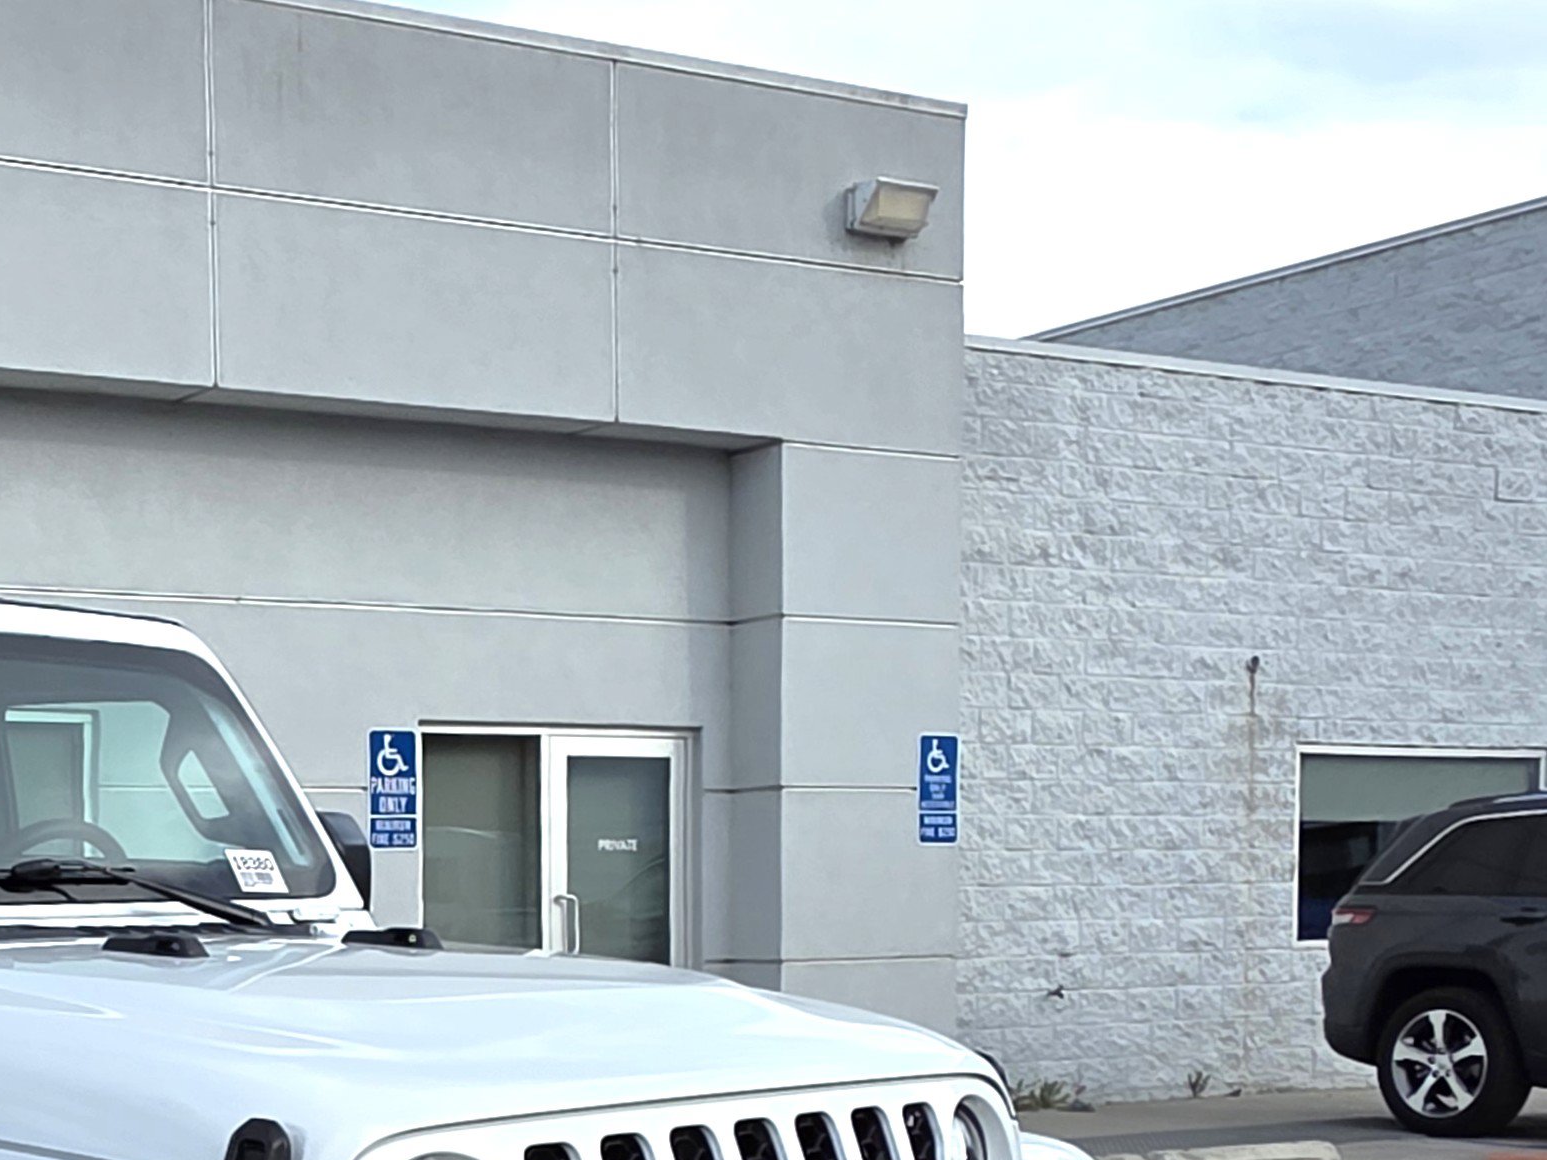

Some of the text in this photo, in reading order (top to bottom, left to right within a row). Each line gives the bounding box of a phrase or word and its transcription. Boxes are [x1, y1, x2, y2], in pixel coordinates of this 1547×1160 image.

[371, 777, 416, 794] PARKING
[378, 796, 408, 813] ONLY
[597, 839, 638, 851] PRIVATE
